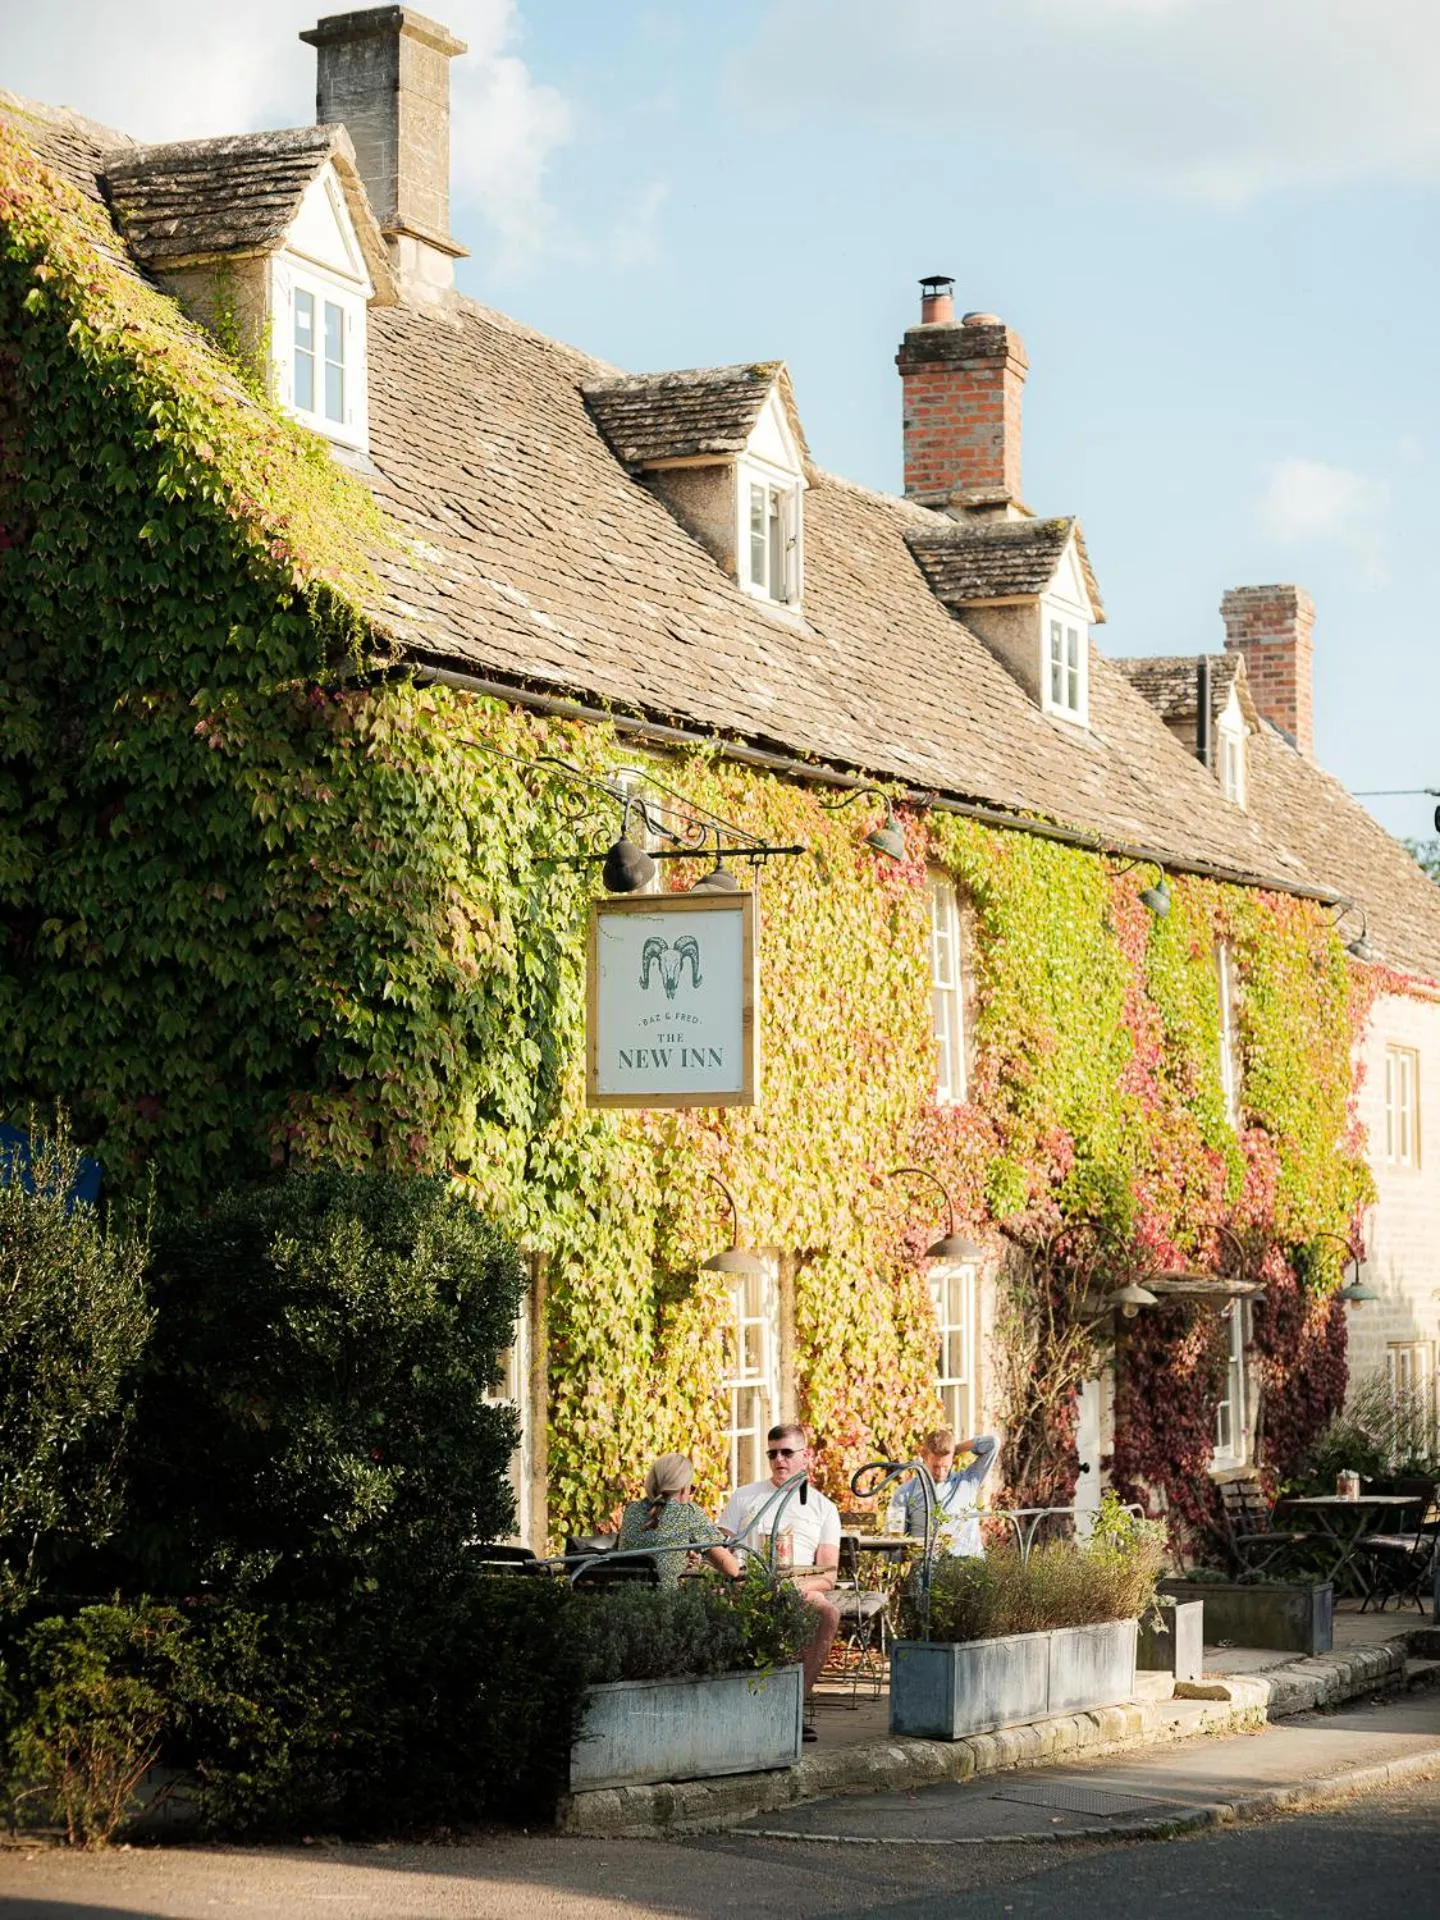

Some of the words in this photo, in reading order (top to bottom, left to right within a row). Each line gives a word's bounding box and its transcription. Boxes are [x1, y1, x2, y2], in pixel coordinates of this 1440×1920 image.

[641, 1013, 661, 1026] BAZ
[676, 1012, 699, 1024] FRED
[657, 1033, 684, 1043] THE
[618, 1048, 673, 1069] NEW
[681, 1047, 723, 1068] INN
